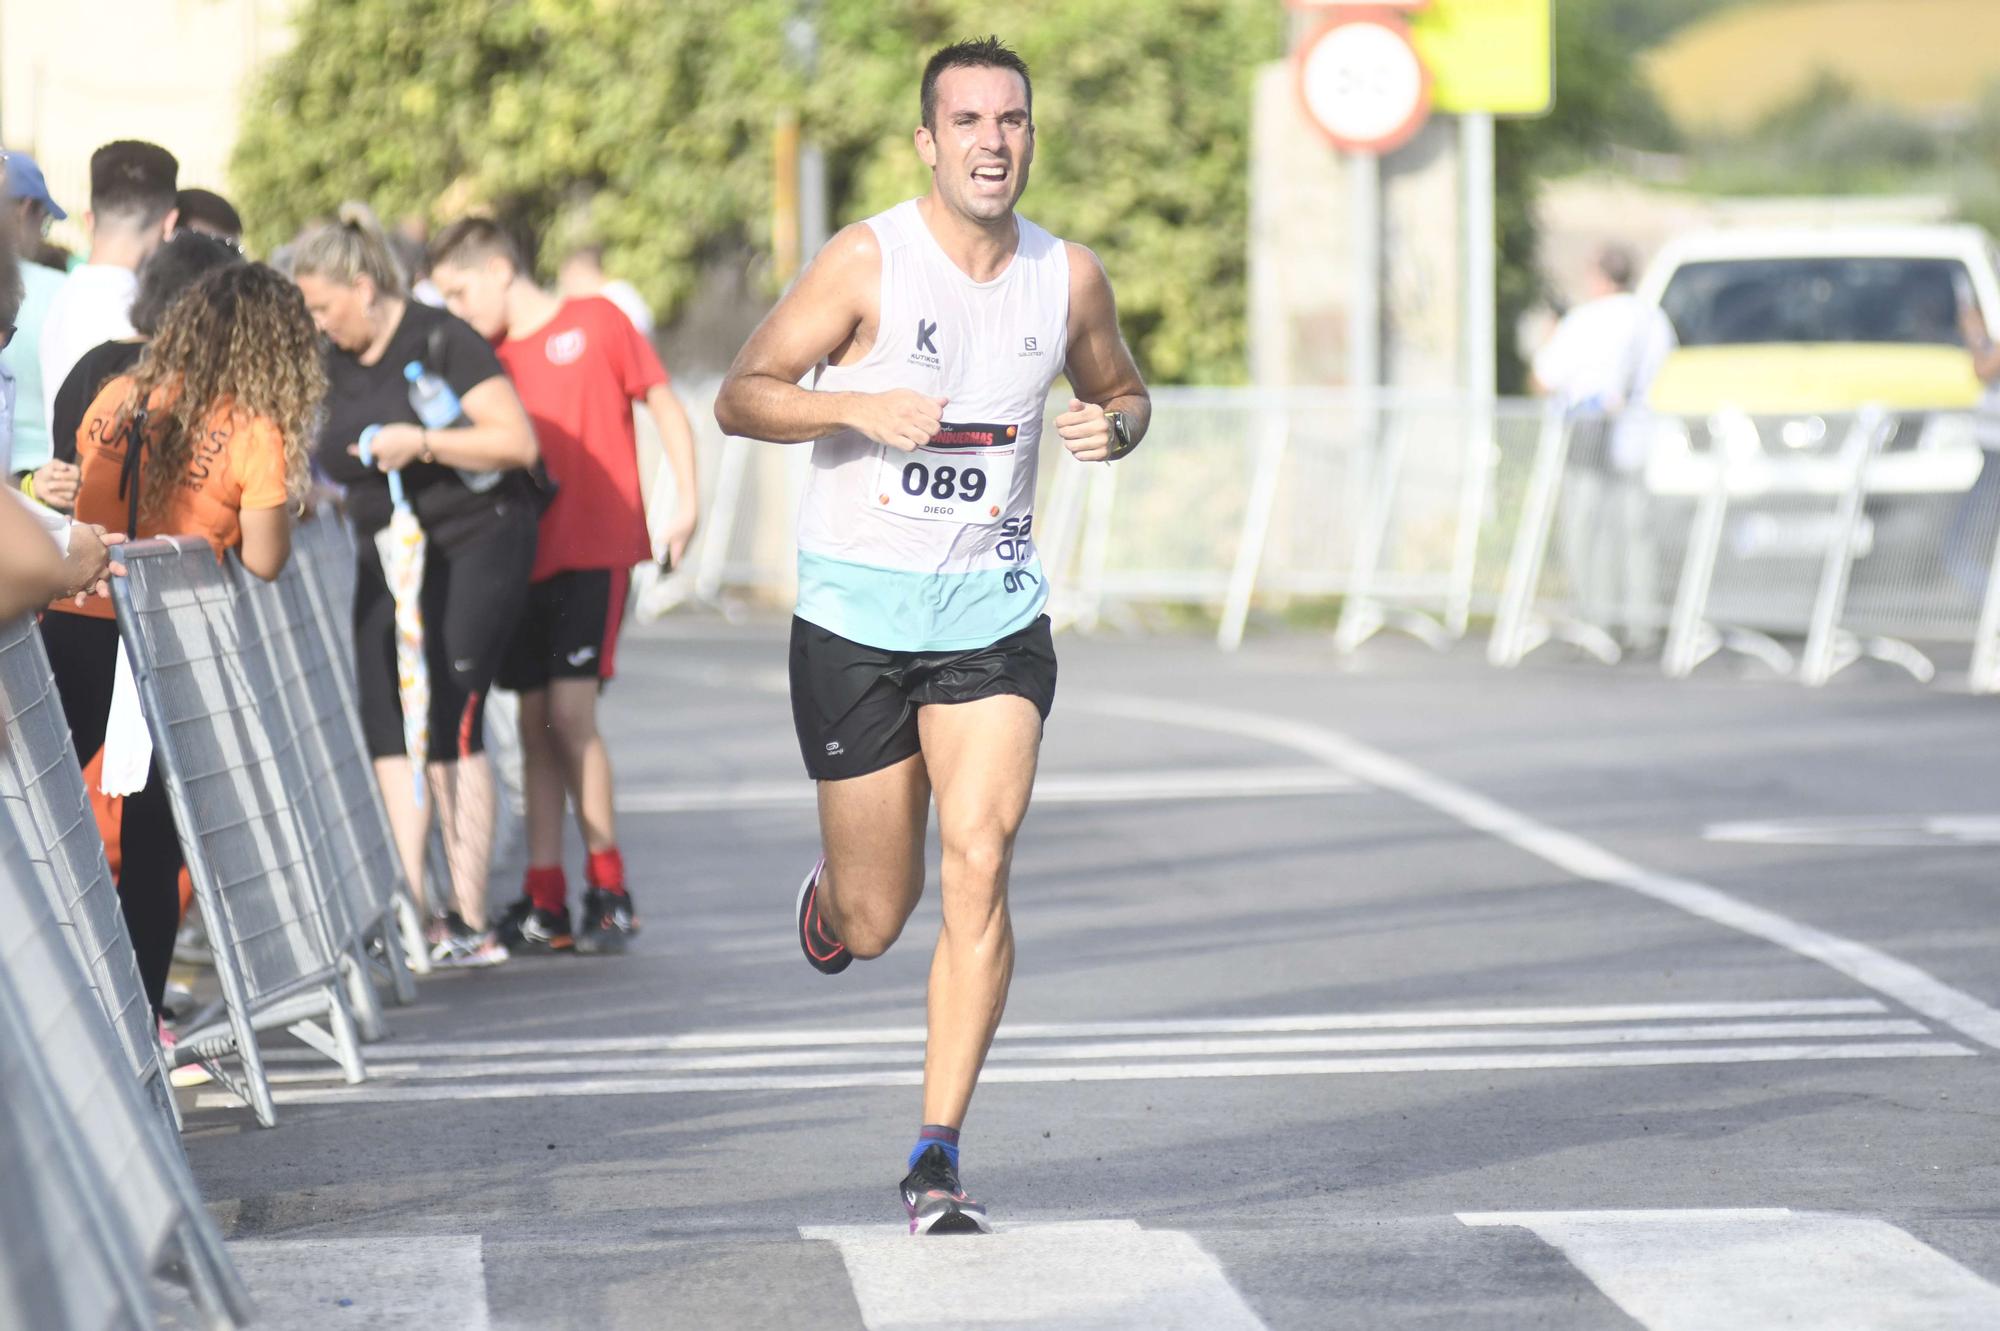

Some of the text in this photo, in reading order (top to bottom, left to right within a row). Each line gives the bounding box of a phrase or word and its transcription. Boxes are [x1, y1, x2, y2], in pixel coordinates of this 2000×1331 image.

[916, 318, 937, 354] K
[902, 462, 987, 502] 089
[923, 505, 955, 516] DIEGO
